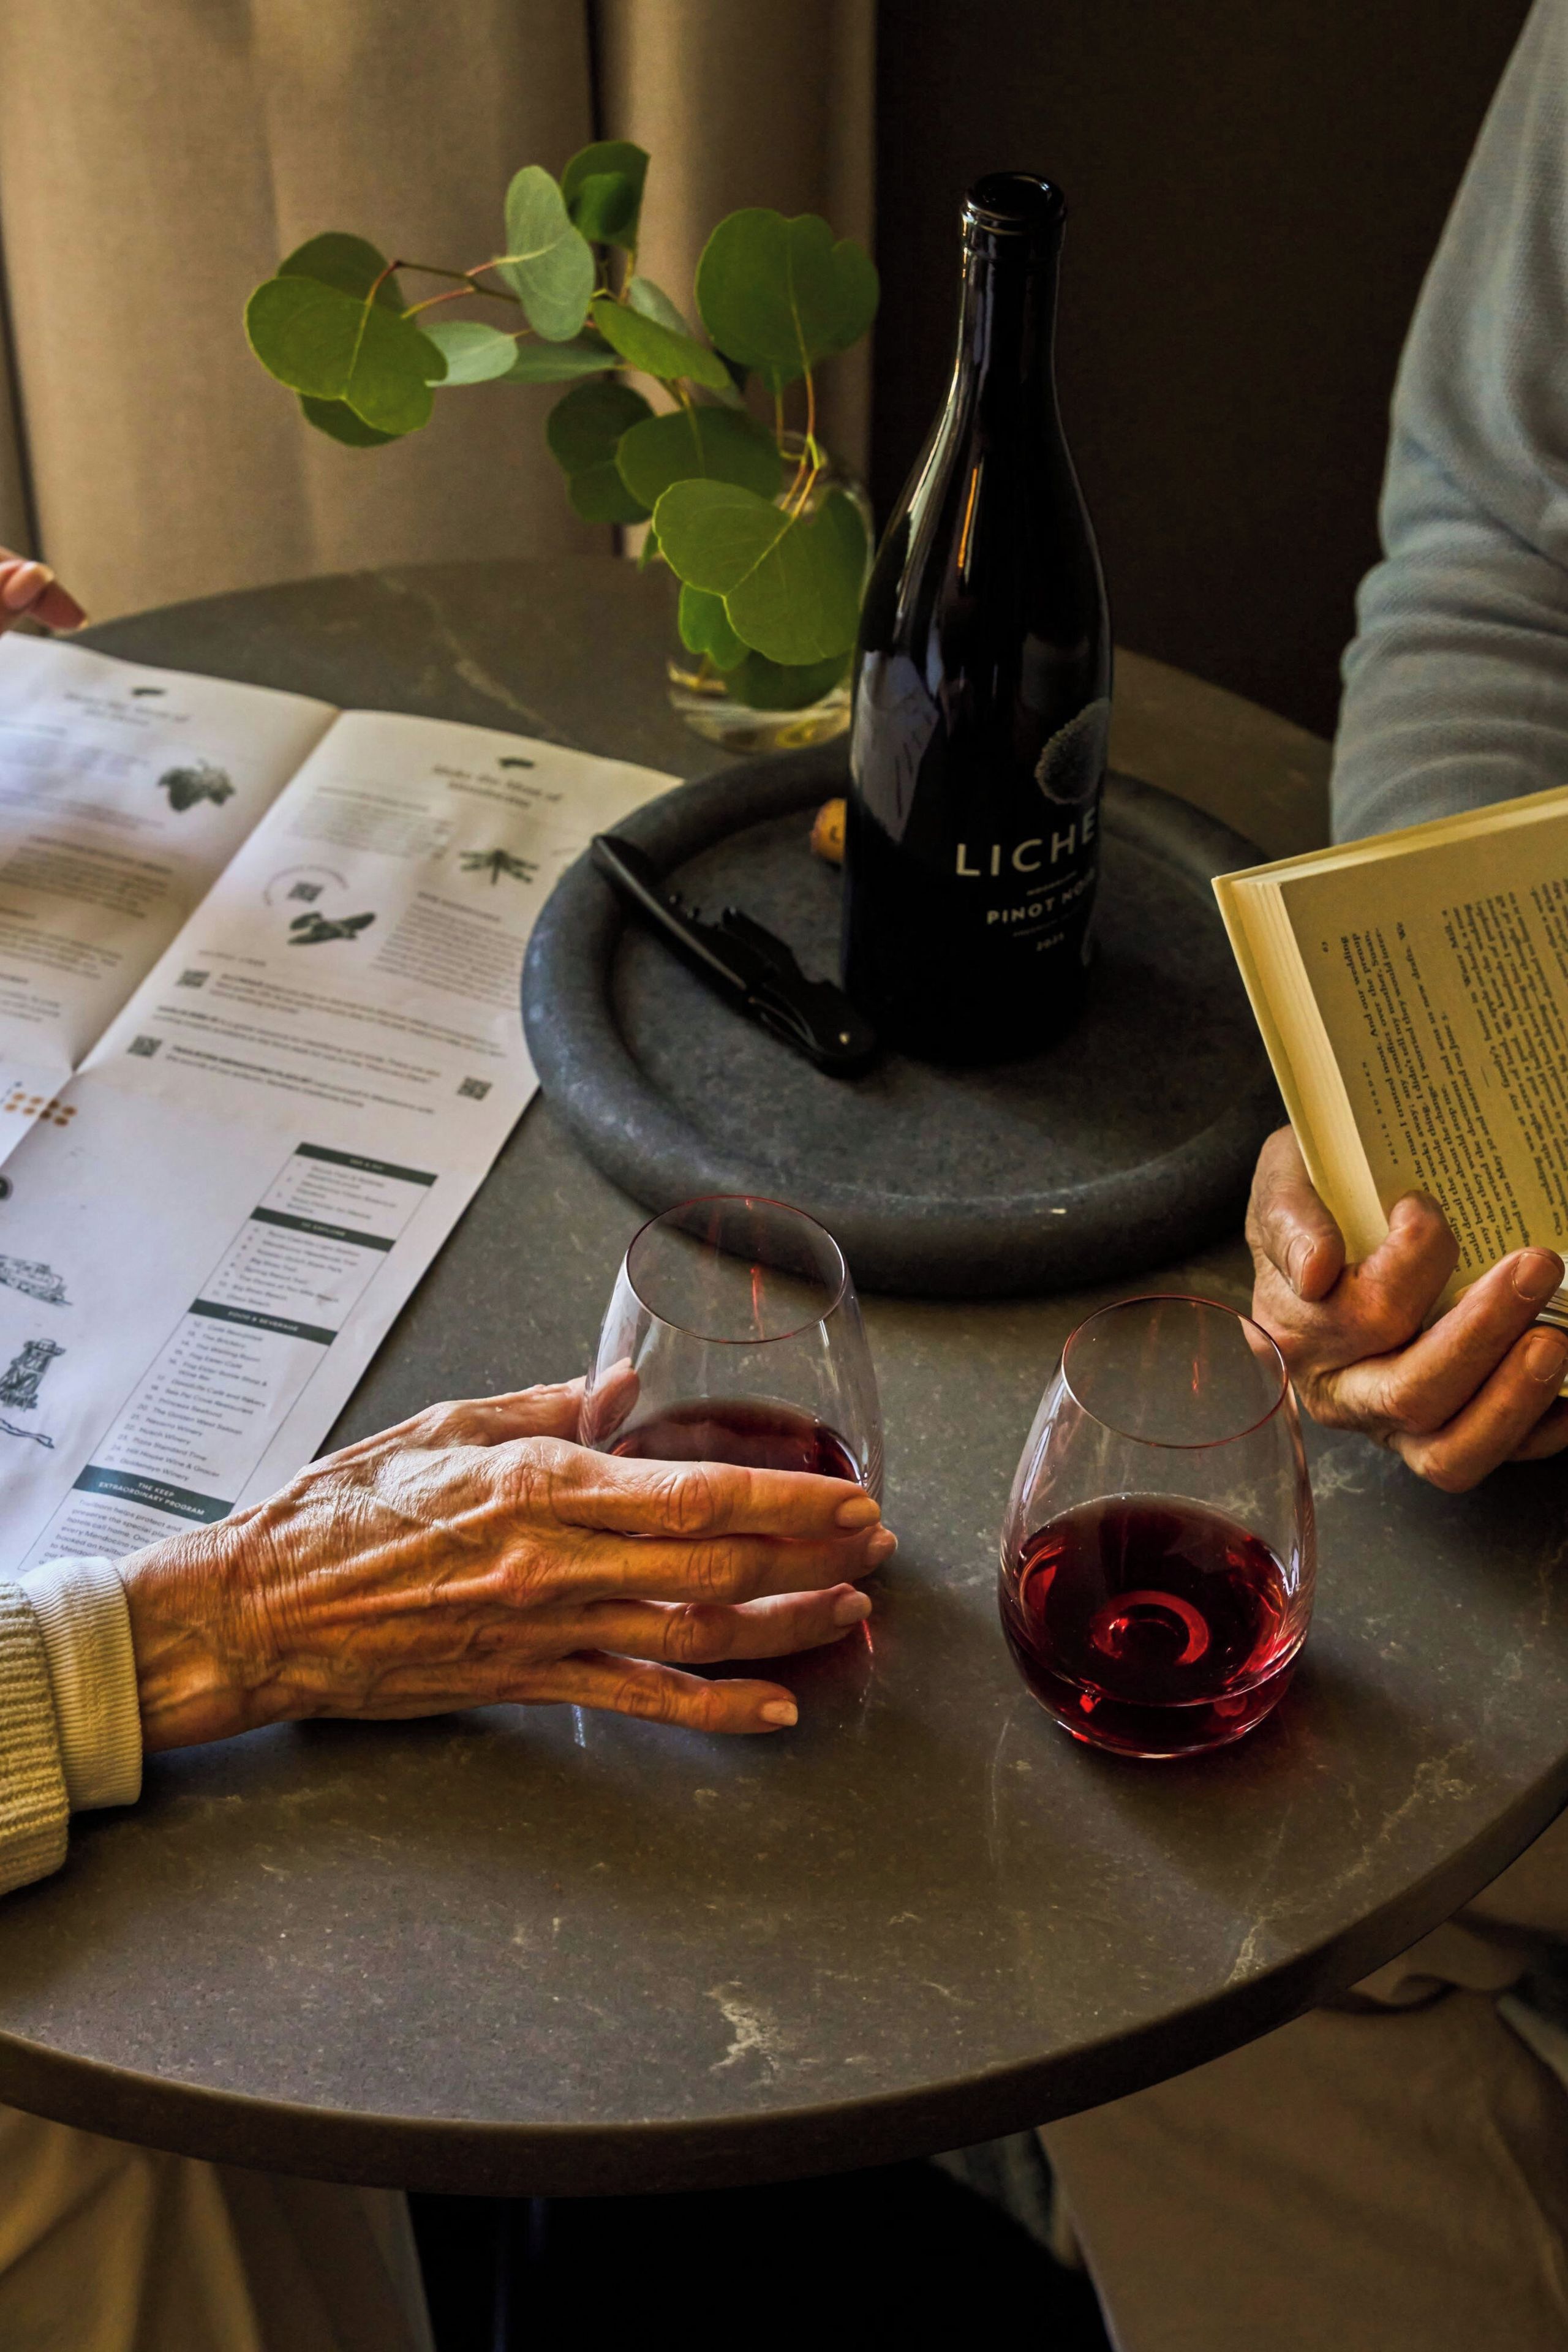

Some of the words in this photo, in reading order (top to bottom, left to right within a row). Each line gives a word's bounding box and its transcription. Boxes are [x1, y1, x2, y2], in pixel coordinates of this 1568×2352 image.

[986, 897, 1056, 925] PINOT
[1375, 927, 1389, 959] inter-
[1396, 922, 1406, 940] We
[1340, 936, 1360, 985] wedding
[1352, 933, 1371, 973] prenup
[1364, 930, 1379, 967] Susan,
[1405, 945, 1420, 980] drafts.
[1366, 978, 1376, 997] the
[1382, 961, 1401, 997] would
[1357, 989, 1368, 1010] our
[1417, 983, 1430, 1008] new
[1363, 1013, 1378, 1037] And
[1374, 1001, 1387, 1027] over
[1398, 1000, 1411, 1025] they
[1427, 1011, 1436, 1024] us
[1392, 1017, 1402, 1035] my
[1444, 1024, 1460, 1050] June
[1396, 1037, 1409, 1056] tell
[1405, 1027, 1426, 1071] worried
[1432, 1028, 1445, 1051] sent
[1376, 1042, 1390, 1074] most.
[1384, 1031, 1403, 1074] conflict
[1439, 1054, 1454, 1076] and
[1453, 1051, 1463, 1067] on
[1362, 1061, 1382, 1114] BURDEN
[1384, 1077, 1404, 1118] trusted
[1400, 1079, 1411, 1099] any
[1441, 1084, 1452, 1105] me.
[1457, 1069, 1480, 1113] married
[1427, 1082, 1445, 1125] change.
[1450, 1080, 1476, 1136] document
[1408, 1104, 1424, 1137] away;
[1422, 1102, 1436, 1136] thing.
[1448, 1107, 1461, 1131] stop
[1475, 1115, 1490, 1136] and
[1381, 1123, 1398, 1164] BELLE
[1404, 1130, 1417, 1156] man
[1442, 1126, 1453, 1145] the
[1486, 1137, 1497, 1151] 30
[1421, 1141, 1436, 1177] weeks
[1433, 1139, 1449, 1174] whole
[1455, 1133, 1475, 1169] would
[1474, 1140, 1485, 1159] the
[1414, 1159, 1424, 1178] the
[1449, 1147, 1466, 1179] about
[1493, 1155, 1506, 1179] May
[1419, 1181, 1430, 1194] as
[1447, 1176, 1458, 1196] the
[1472, 1173, 1487, 1197] they
[1479, 1162, 1502, 1202] revised
[1503, 1181, 1513, 1197] on
[1435, 1182, 1450, 1212] three
[1462, 1182, 1483, 1224] brother
[1510, 1199, 1518, 1209] it
[1452, 1197, 1471, 1229] derail
[1483, 1200, 1496, 1223] that
[1499, 1205, 1513, 1234] Tom
[1449, 1216, 1462, 1244] only
[1480, 1226, 1491, 1245] my
[1494, 1224, 1507, 1256] vene,
[1512, 1210, 1530, 1247] signed
[1455, 1246, 1472, 1268] was
[1466, 1231, 1484, 1264] could
[1487, 1247, 1496, 1260] or
[227, 1310, 251, 1320] FOOD
[258, 1317, 298, 1332] BEVERAGE
[98, 1482, 163, 1502] EXTRAORDINARY
[164, 1499, 205, 1515] PROGRAM
[138, 1482, 153, 1491] THE
[154, 1487, 175, 1497] KEEP
[66, 1517, 91, 1527] hotels
[107, 1526, 130, 1538] home.
[132, 1533, 149, 1544] One
[72, 1509, 108, 1521] preserve
[123, 1521, 151, 1533] special
[113, 1507, 135, 1518] helps
[135, 1514, 165, 1527] protect
[165, 1524, 182, 1532] and
[55, 1534, 86, 1546] booked
[98, 1545, 127, 1557] trailbo
[61, 1526, 84, 1536] every
[85, 1531, 129, 1548] Mendocino
